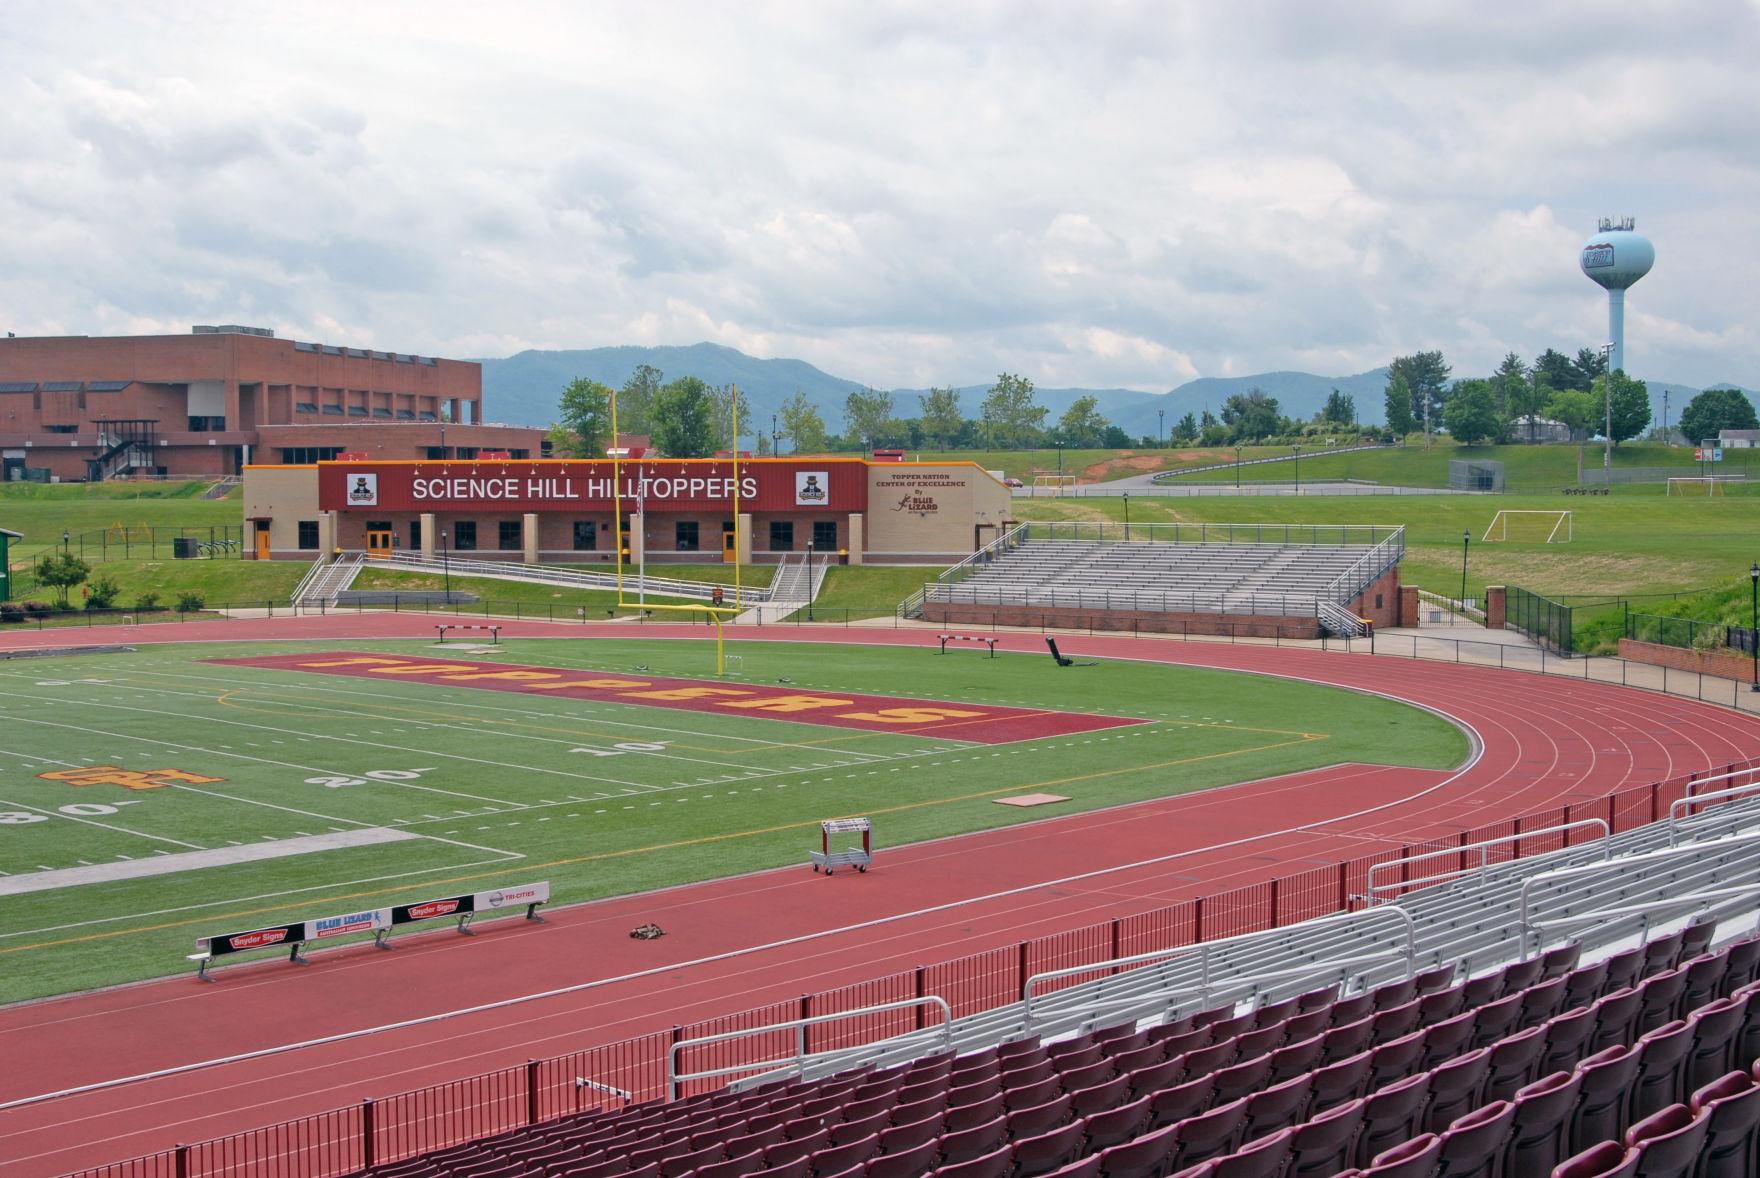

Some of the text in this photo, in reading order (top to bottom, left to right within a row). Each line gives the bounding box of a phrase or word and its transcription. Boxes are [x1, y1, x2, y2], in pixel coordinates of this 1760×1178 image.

[412, 477, 757, 499] SCIENCE HILL HILLTOPPERS
[297, 656, 990, 723] TOPPERS
[568, 742, 666, 757] 10
[304, 769, 421, 788] 20
[505, 889, 534, 902] TRI-CITIES
[412, 903, 456, 917] Snyder Signs
[316, 918, 341, 931] BLUE
[234, 931, 286, 950] Snyder Signs
